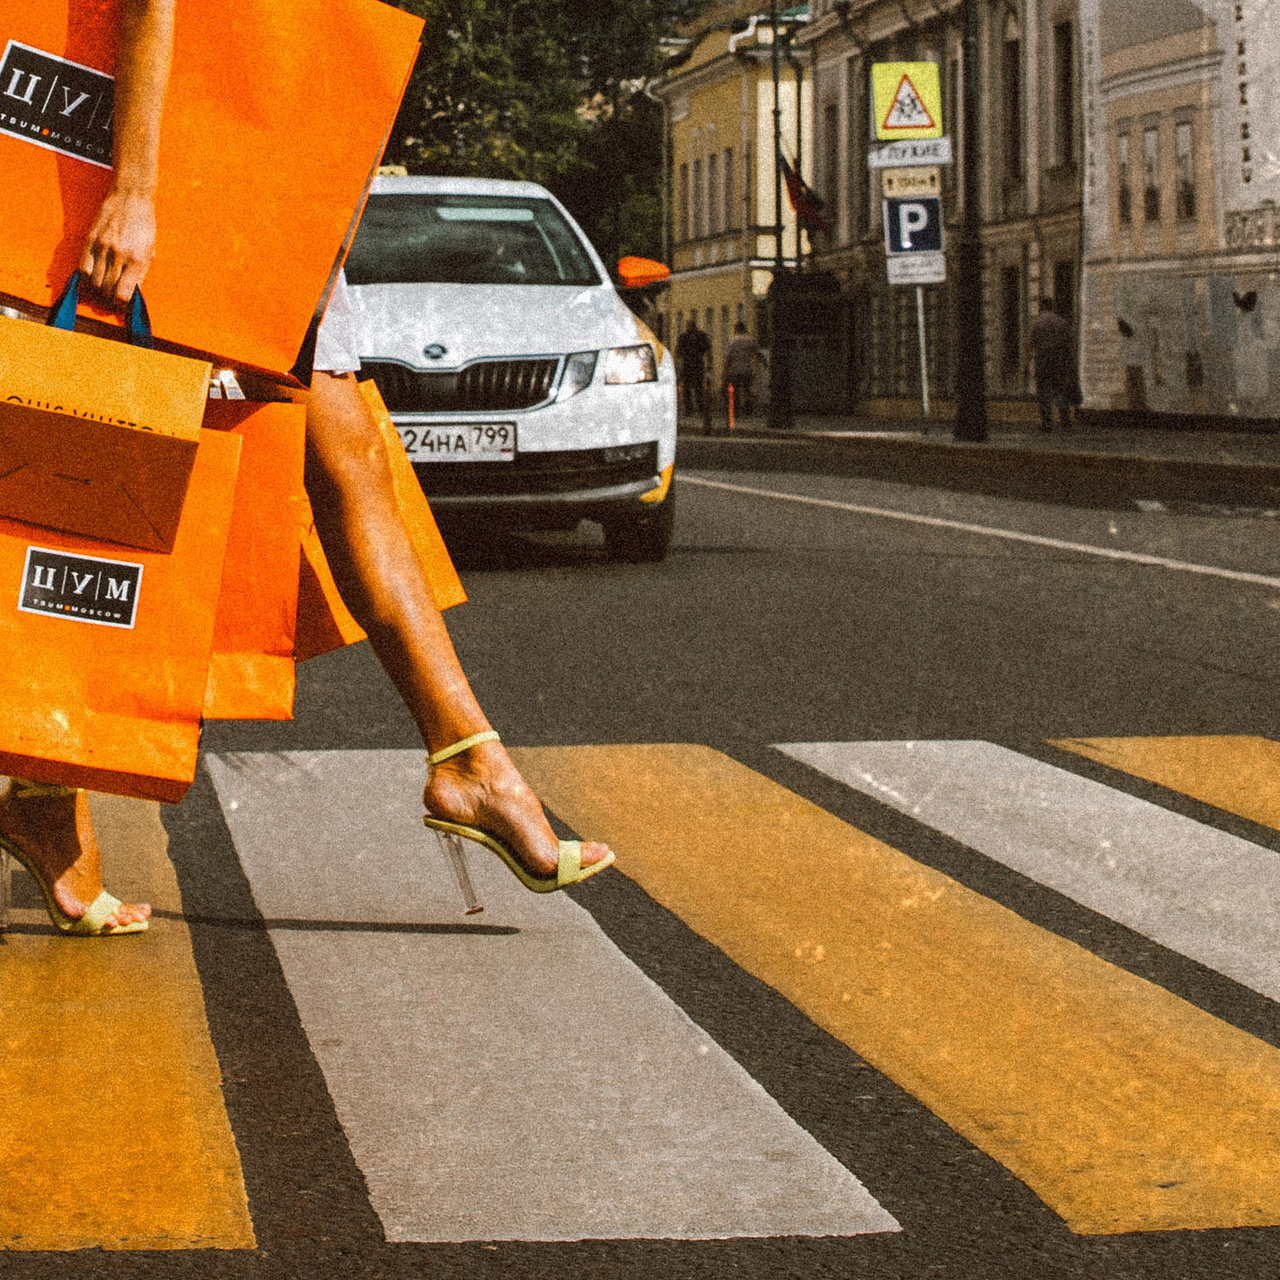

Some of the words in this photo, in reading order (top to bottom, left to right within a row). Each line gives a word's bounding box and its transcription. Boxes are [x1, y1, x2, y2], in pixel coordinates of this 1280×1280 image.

[3, 68, 113, 129] ЦУ
[0, 113, 40, 133] TSUM
[51, 132, 113, 157] MOSCO
[898, 202, 929, 249] P
[397, 428, 467, 454] 24НА
[473, 427, 509, 445] 799
[33, 598, 63, 609] TSUM
[71, 605, 121, 619] MOSCOW
